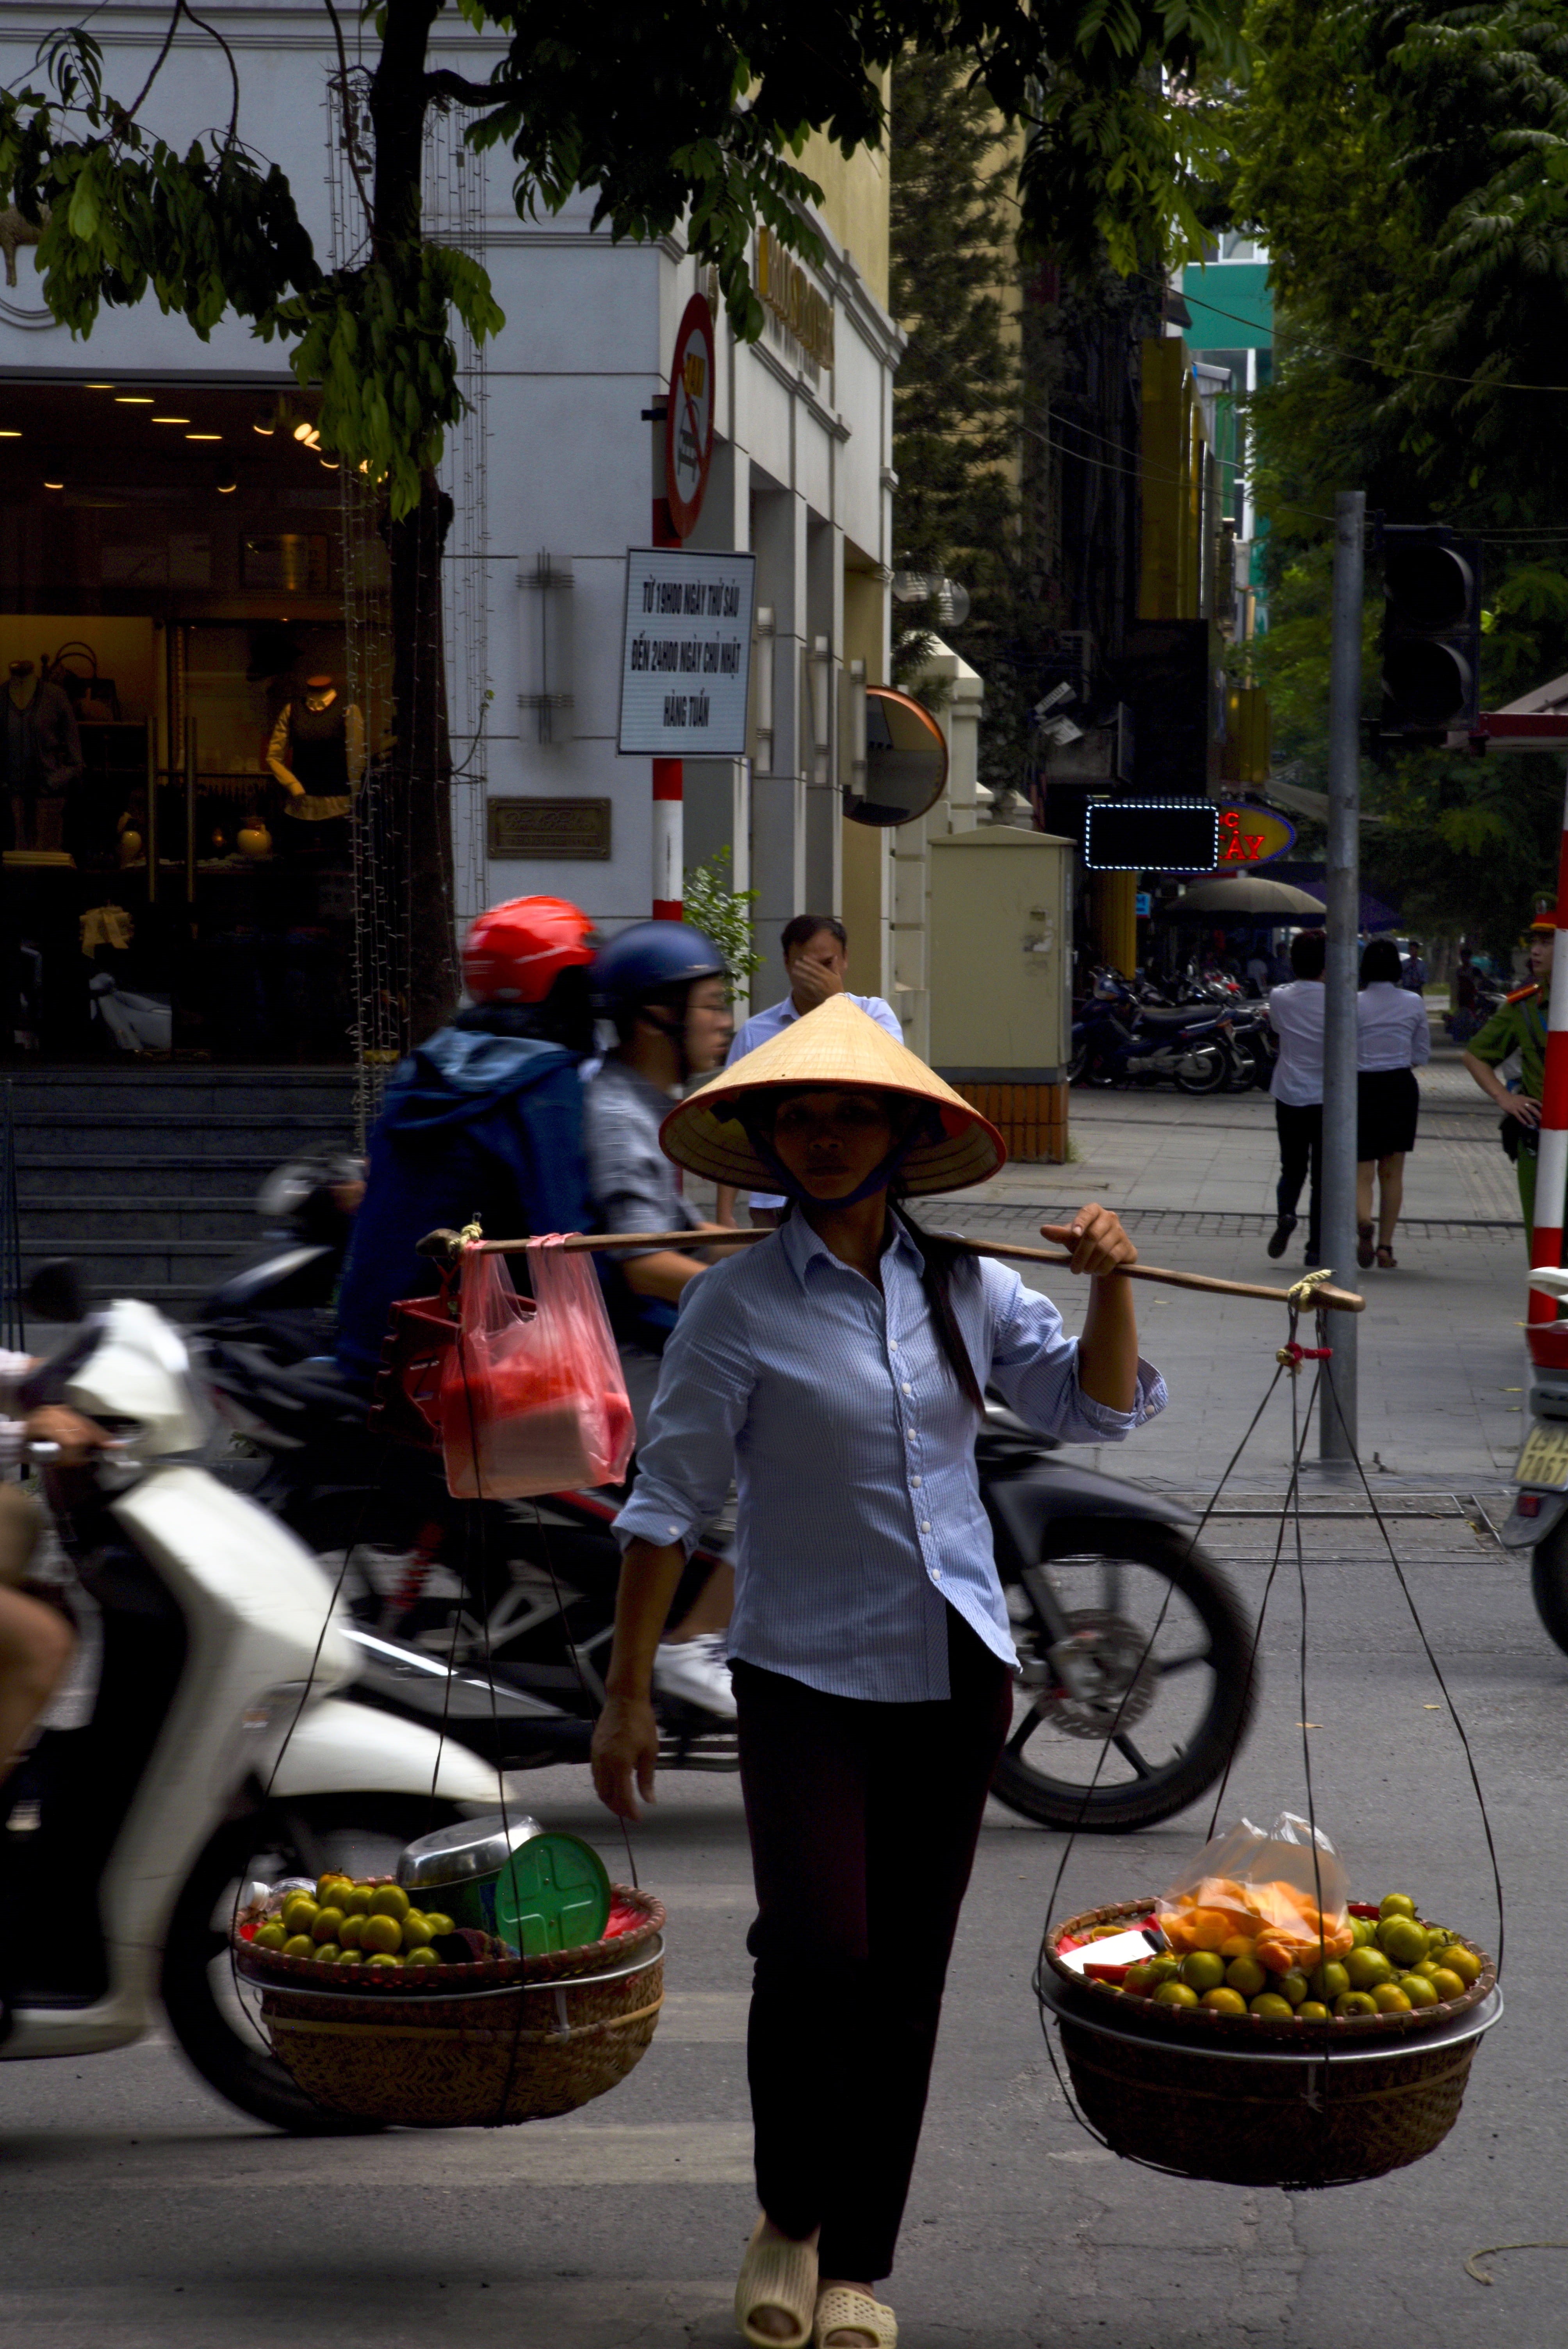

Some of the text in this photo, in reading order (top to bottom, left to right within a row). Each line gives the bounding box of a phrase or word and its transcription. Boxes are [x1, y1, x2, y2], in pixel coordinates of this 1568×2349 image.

[643, 574, 740, 617] TỪ 19H00 NGÀY THỨ SÁU
[631, 630, 741, 679] ĐẾN 24H00 NGÀY CHỦ NHẬT
[663, 689, 687, 727] HÀNG
